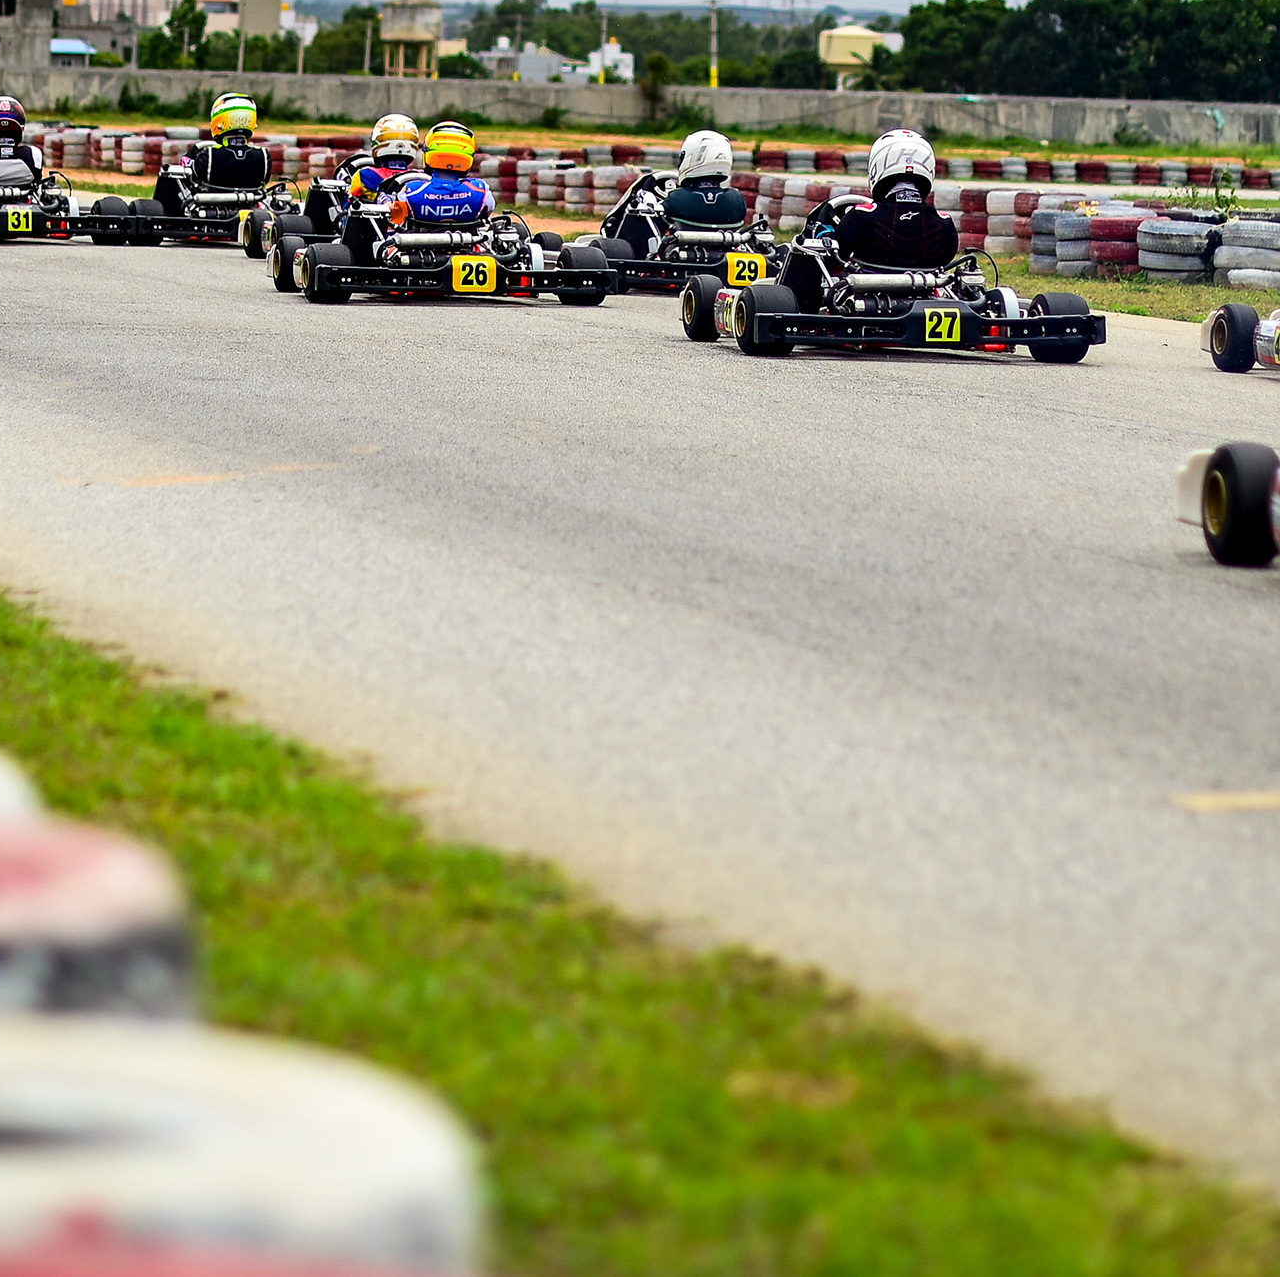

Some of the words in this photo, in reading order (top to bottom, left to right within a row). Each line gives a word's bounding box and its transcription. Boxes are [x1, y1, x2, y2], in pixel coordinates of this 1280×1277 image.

[424, 191, 471, 201] NIKHILESH
[420, 203, 472, 216] INDIA
[11, 211, 31, 229] 31
[461, 262, 488, 286] 26
[735, 259, 759, 282] 29
[928, 311, 958, 339] 27
